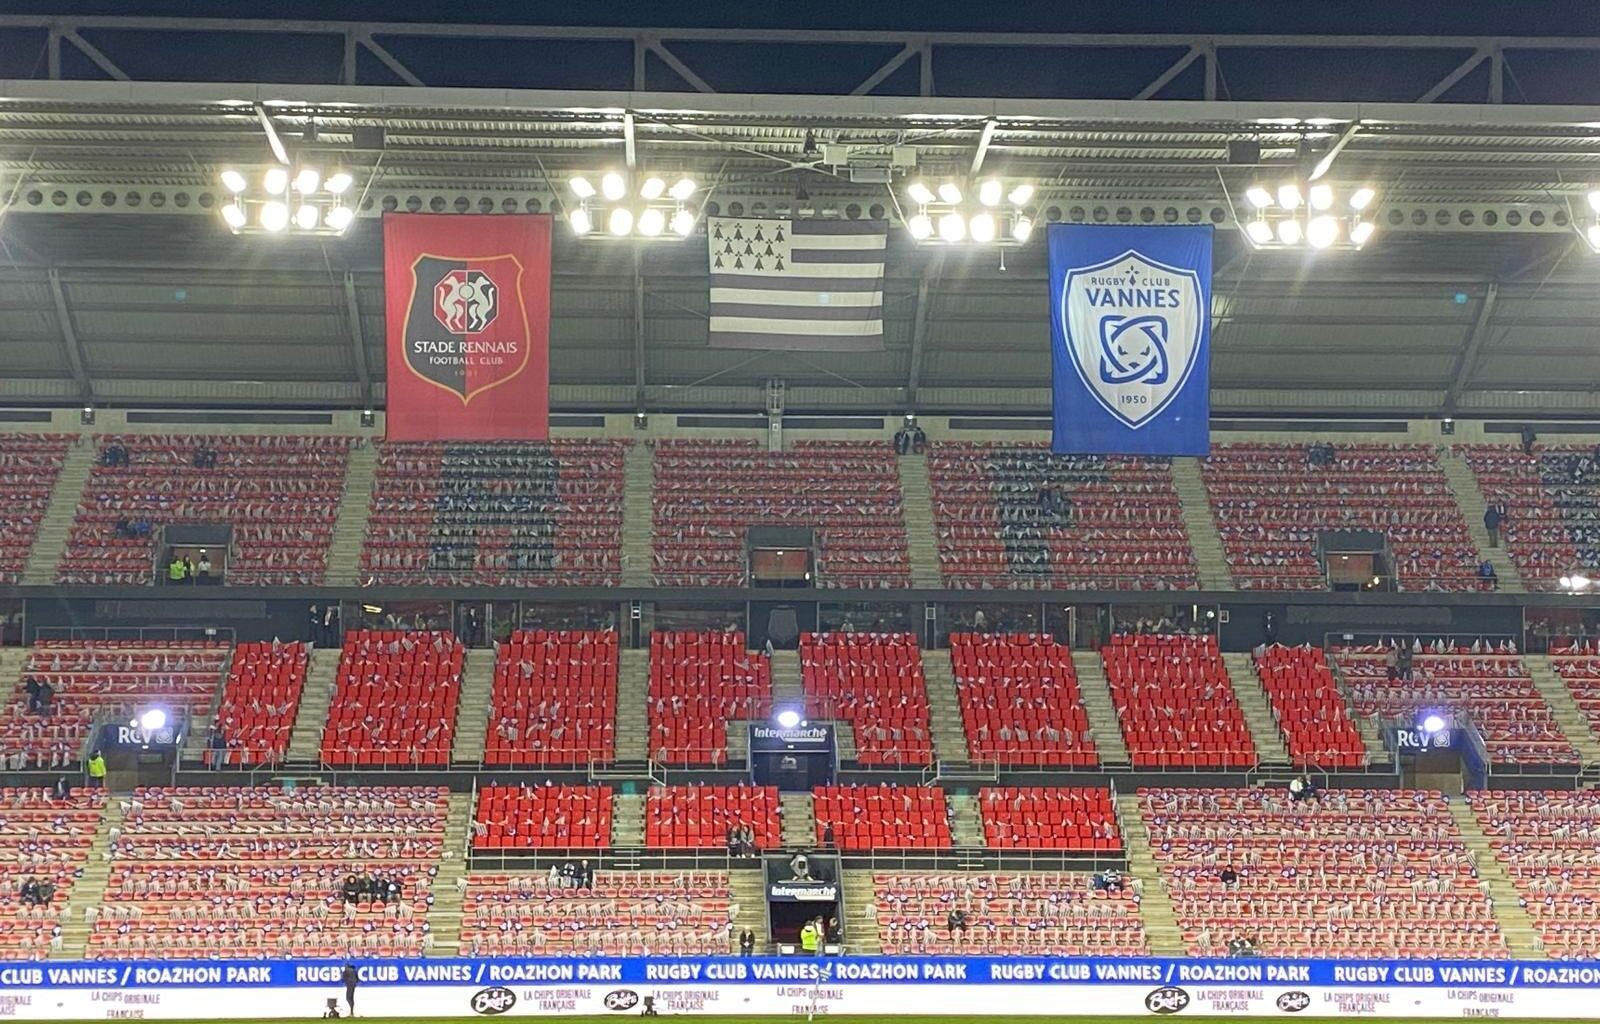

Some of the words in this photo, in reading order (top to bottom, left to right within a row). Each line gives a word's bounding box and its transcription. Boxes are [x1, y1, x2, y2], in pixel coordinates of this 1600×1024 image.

[1091, 277, 1126, 286] RUGBY
[1141, 277, 1170, 286] CLUB
[1085, 288, 1181, 308] VANNES
[414, 341, 456, 353] STADE
[459, 341, 518, 353] RENNAIS
[429, 356, 474, 365] FOOTBALL
[479, 357, 503, 365] CLUB
[1120, 395, 1148, 405] 1950
[0, 968, 43, 984] CLUB
[48, 968, 117, 984] VANNES
[136, 967, 221, 984] ROAZHON
[227, 967, 271, 983] PARK
[296, 966, 346, 982] RUGB
[357, 966, 399, 982] CLUB
[405, 965, 472, 981] VANNES
[490, 964, 573, 981] ROAZHON
[578, 964, 622, 980] PARK
[646, 964, 701, 980] RUGBY
[706, 964, 747, 980] CLUB
[752, 963, 819, 980] VANNES
[836, 963, 919, 980] ROAZHON
[923, 964, 967, 980] PARK
[991, 964, 1045, 980] RUGBY
[1049, 964, 1091, 980] CLUB
[1096, 964, 1162, 981] VANNES
[1180, 965, 1262, 981] ROAZHON
[1267, 965, 1310, 981] PARK
[1334, 966, 1389, 982] RUGBY
[1394, 966, 1435, 983] CLUB
[1440, 967, 1506, 983] VANNES
[1524, 967, 1600, 984] ROAZHON
[523, 991, 533, 1001] LA
[1196, 990, 1206, 1001] LA
